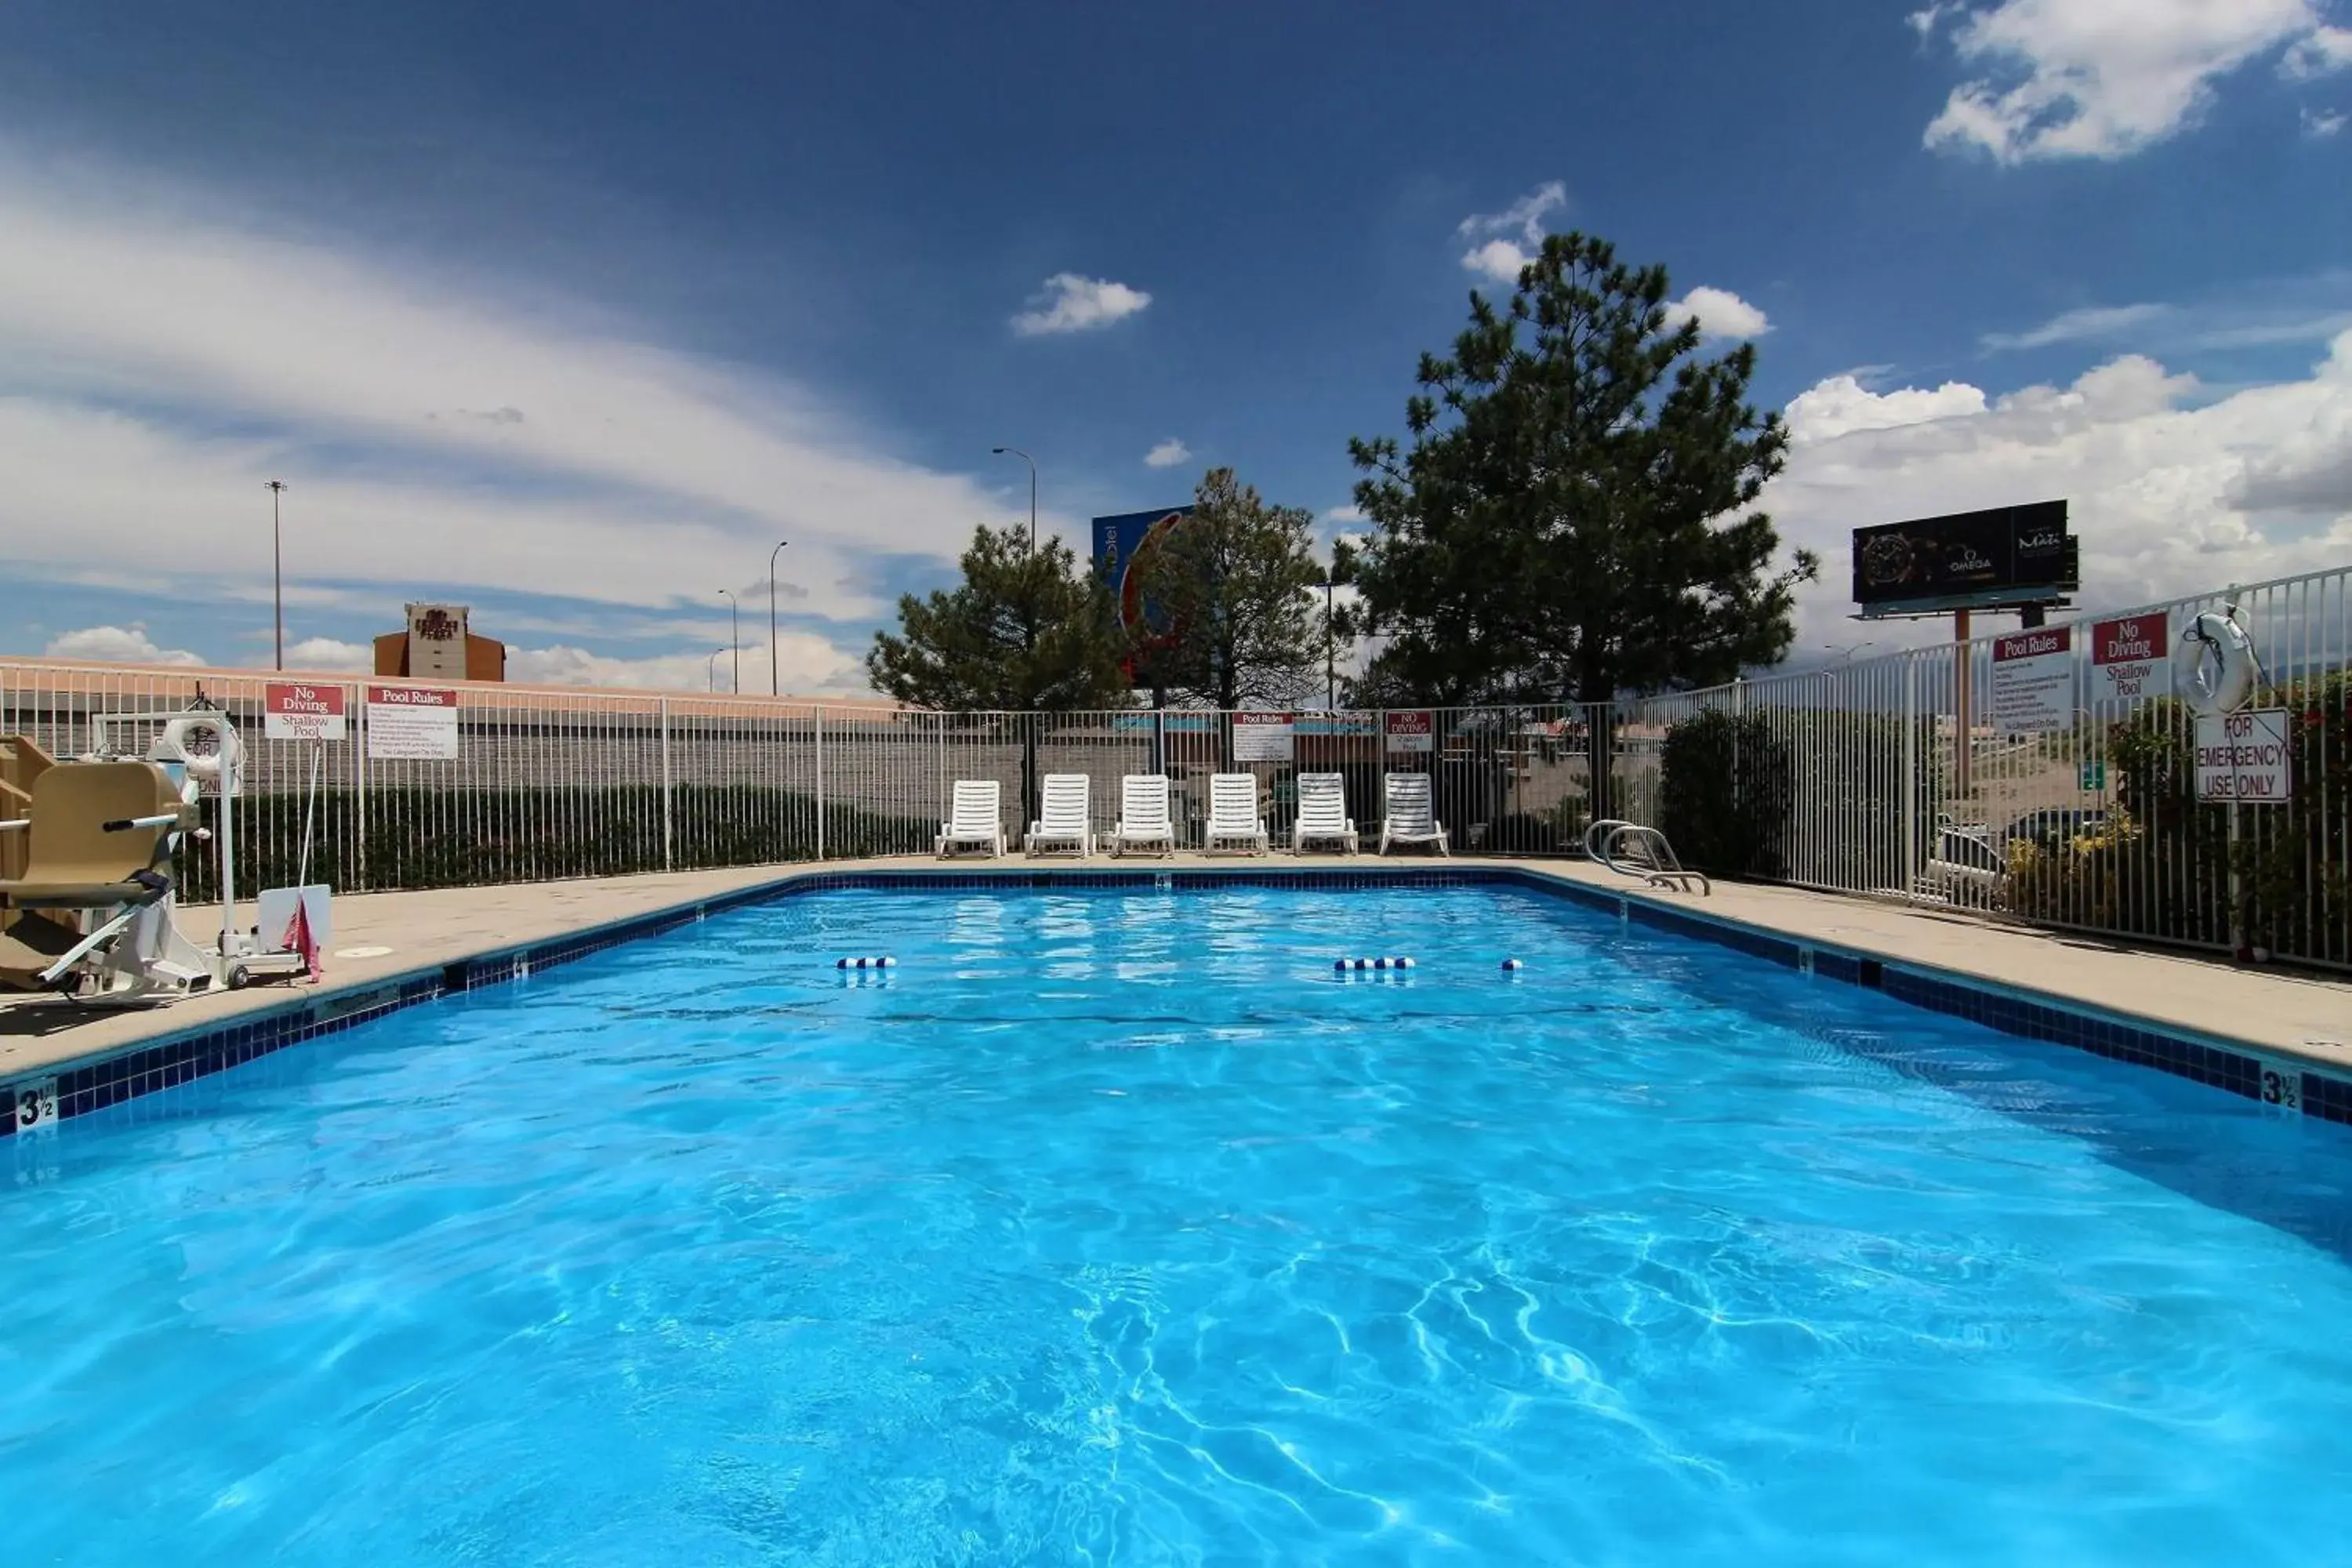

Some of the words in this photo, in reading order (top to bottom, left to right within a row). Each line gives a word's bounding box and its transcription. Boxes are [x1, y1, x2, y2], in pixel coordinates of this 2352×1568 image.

[1950, 559, 1991, 572] OMEGA
[2119, 620, 2139, 639] No
[2005, 639, 2027, 658] Pool
[2029, 635, 2058, 653] Rules
[2107, 637, 2151, 659] Diving
[2107, 663, 2152, 681] Shallow
[295, 686, 315, 699] No
[2117, 679, 2141, 696] Pool
[383, 690, 408, 702] Pool
[412, 691, 443, 704] Rules
[283, 697, 328, 715] Diving
[282, 715, 328, 726] Shallow
[1243, 714, 1260, 723] Pool
[1261, 714, 1283, 724] Rules
[1401, 714, 1417, 723] NO
[2224, 716, 2252, 738] FOR
[293, 726, 319, 736] Pool
[1392, 723, 1427, 733] DIVING
[2198, 744, 2285, 767] EMERGENCY
[2205, 775, 2233, 795] USE
[2238, 775, 2275, 795] ONLY
